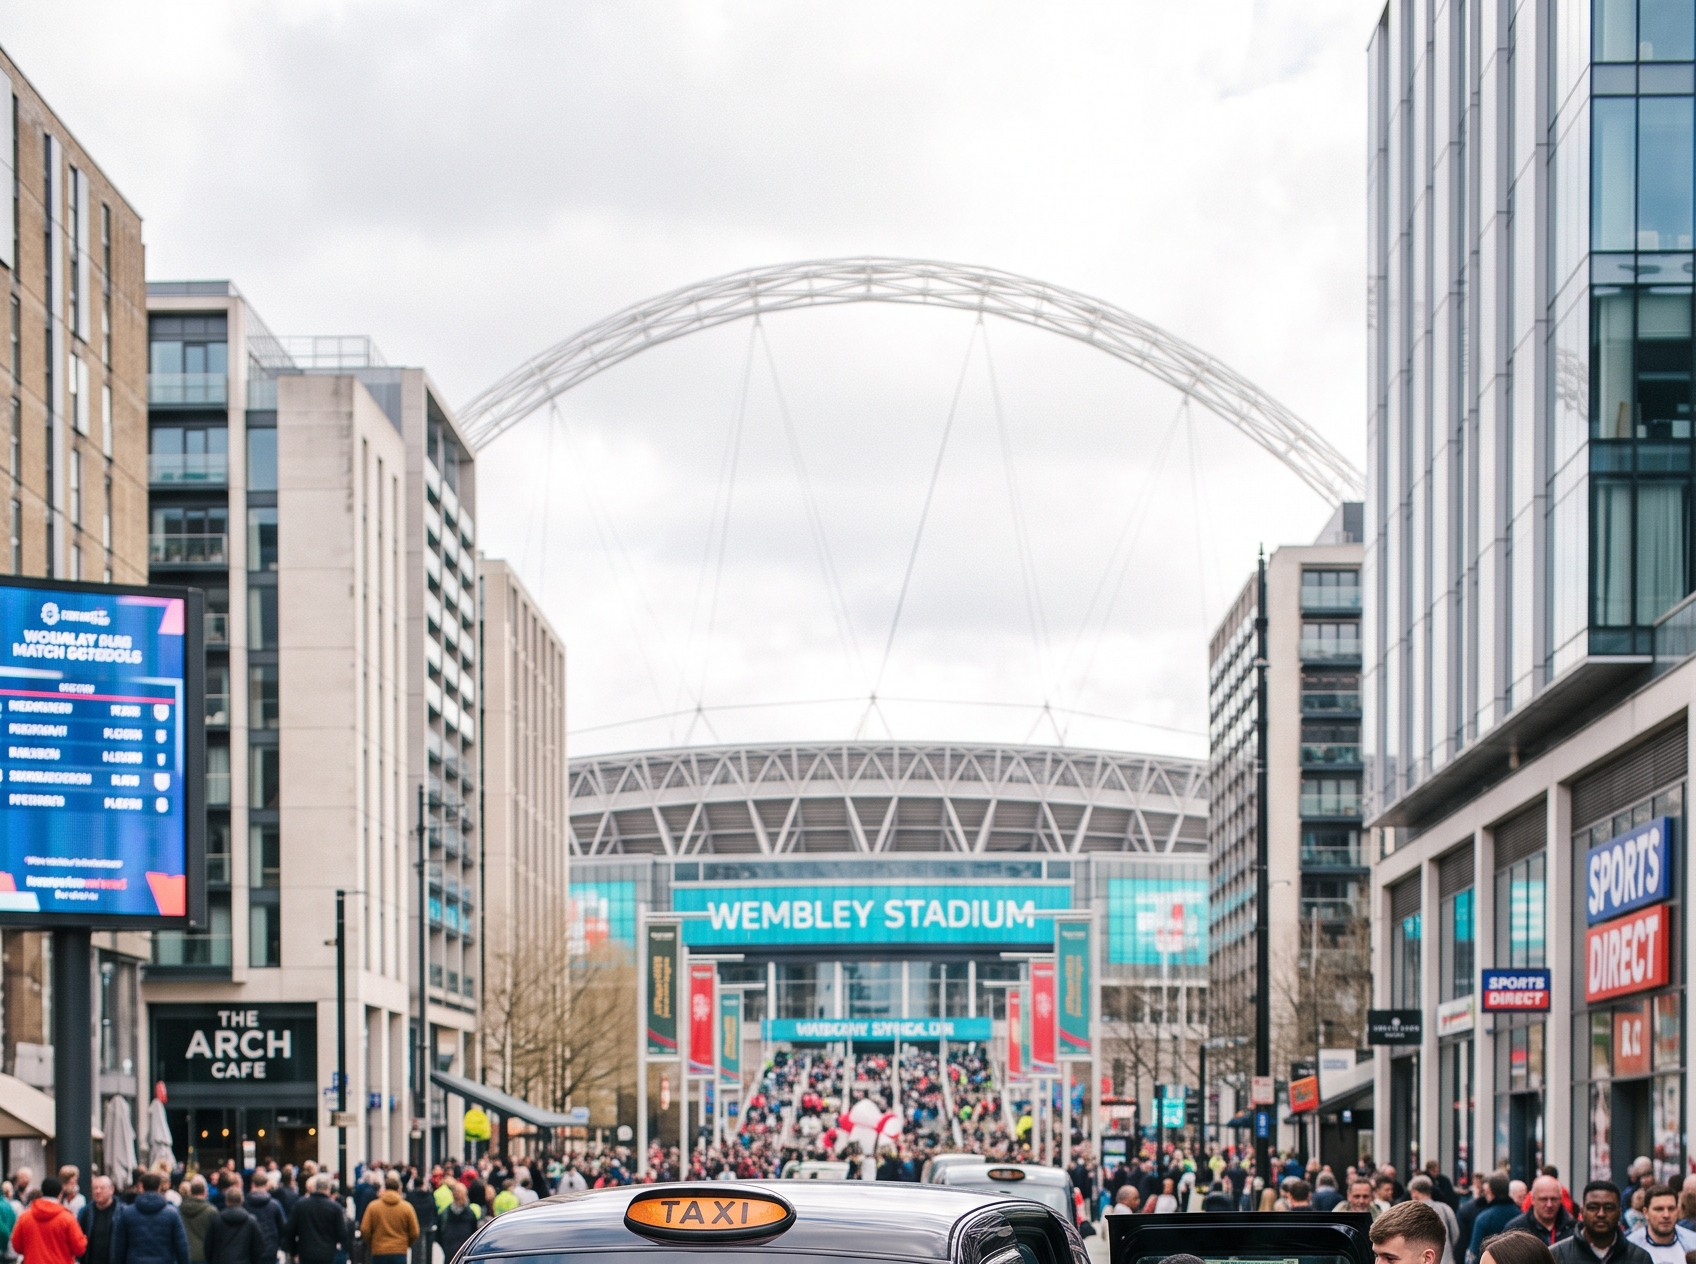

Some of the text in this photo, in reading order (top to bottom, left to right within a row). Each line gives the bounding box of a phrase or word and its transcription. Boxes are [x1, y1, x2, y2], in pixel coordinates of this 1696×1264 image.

[12, 642, 66, 660] MATCH
[1588, 827, 1660, 916] SPORTS
[707, 899, 1035, 930] WEMBLEY STADIUM
[1588, 914, 1660, 994] DIRECT
[1488, 976, 1545, 990] SPORTS
[1488, 991, 1544, 1006] DIRECT
[218, 1010, 259, 1028] THE
[185, 1030, 292, 1059] ARCH
[211, 1061, 267, 1079] CAFE
[660, 1200, 749, 1225] TAXI
